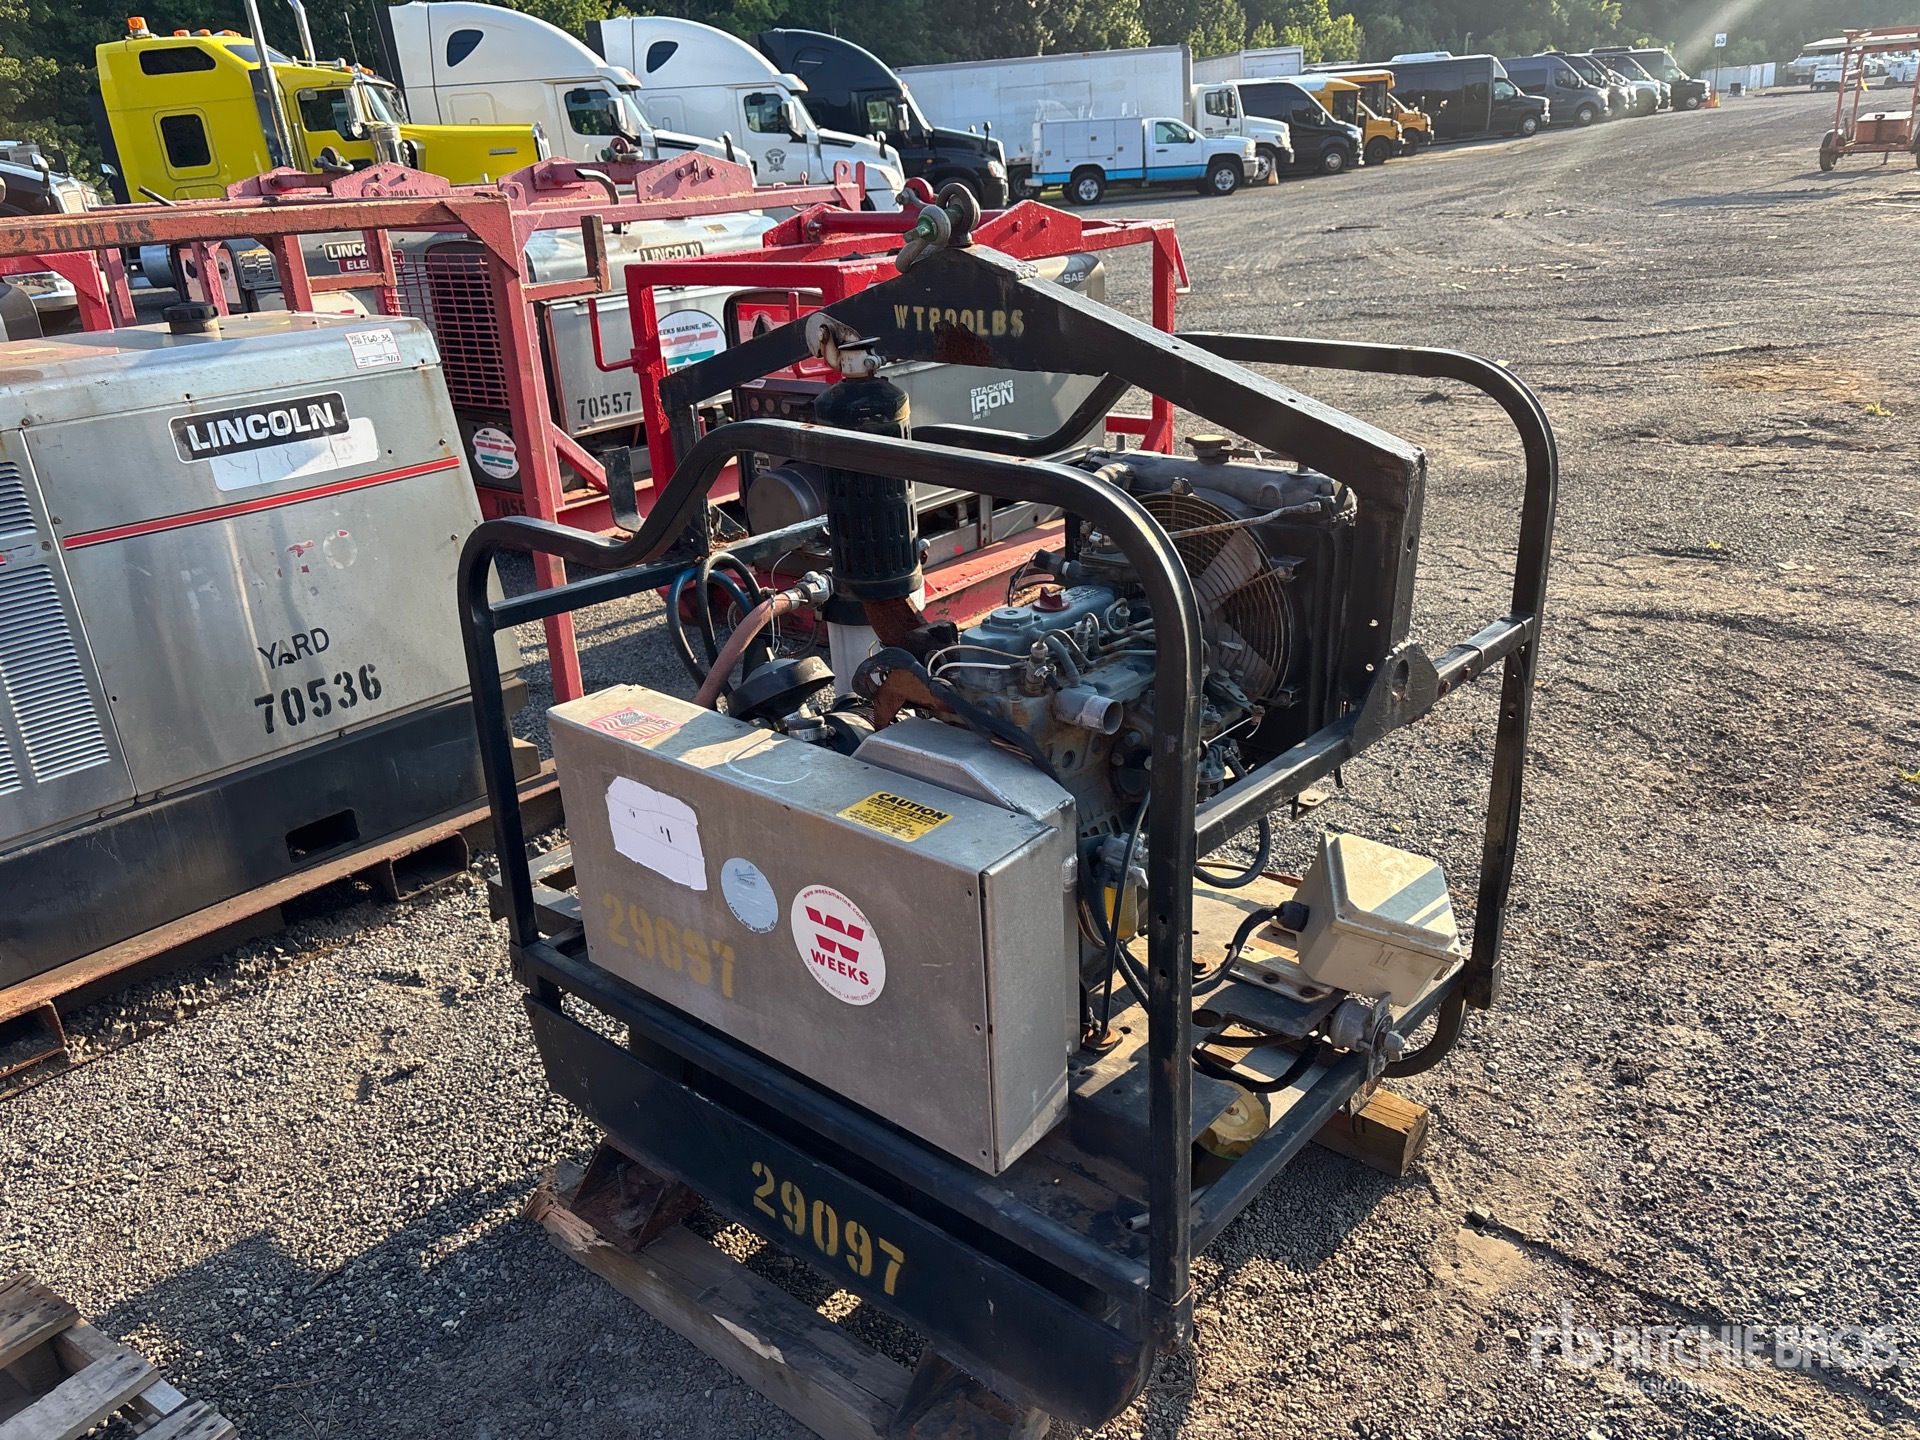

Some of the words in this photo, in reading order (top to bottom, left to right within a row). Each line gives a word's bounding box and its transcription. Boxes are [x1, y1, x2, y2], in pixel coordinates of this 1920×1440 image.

[328, 243, 367, 259] LINC
[1064, 272, 1084, 283] SAE
[659, 327, 675, 336] EEKS
[676, 324, 701, 335] MARINE,
[702, 321, 715, 330] INC.
[971, 379, 1014, 397] STACKING
[971, 387, 1014, 413] IRON
[577, 392, 632, 420] 70557
[186, 401, 336, 451] LINCOLN
[257, 627, 330, 669] YARD
[254, 663, 382, 734] 70536
[877, 793, 949, 820] CAUTION
[603, 892, 736, 999] 29097
[810, 948, 870, 986] WEEKS
[751, 1161, 905, 1296] 29097
